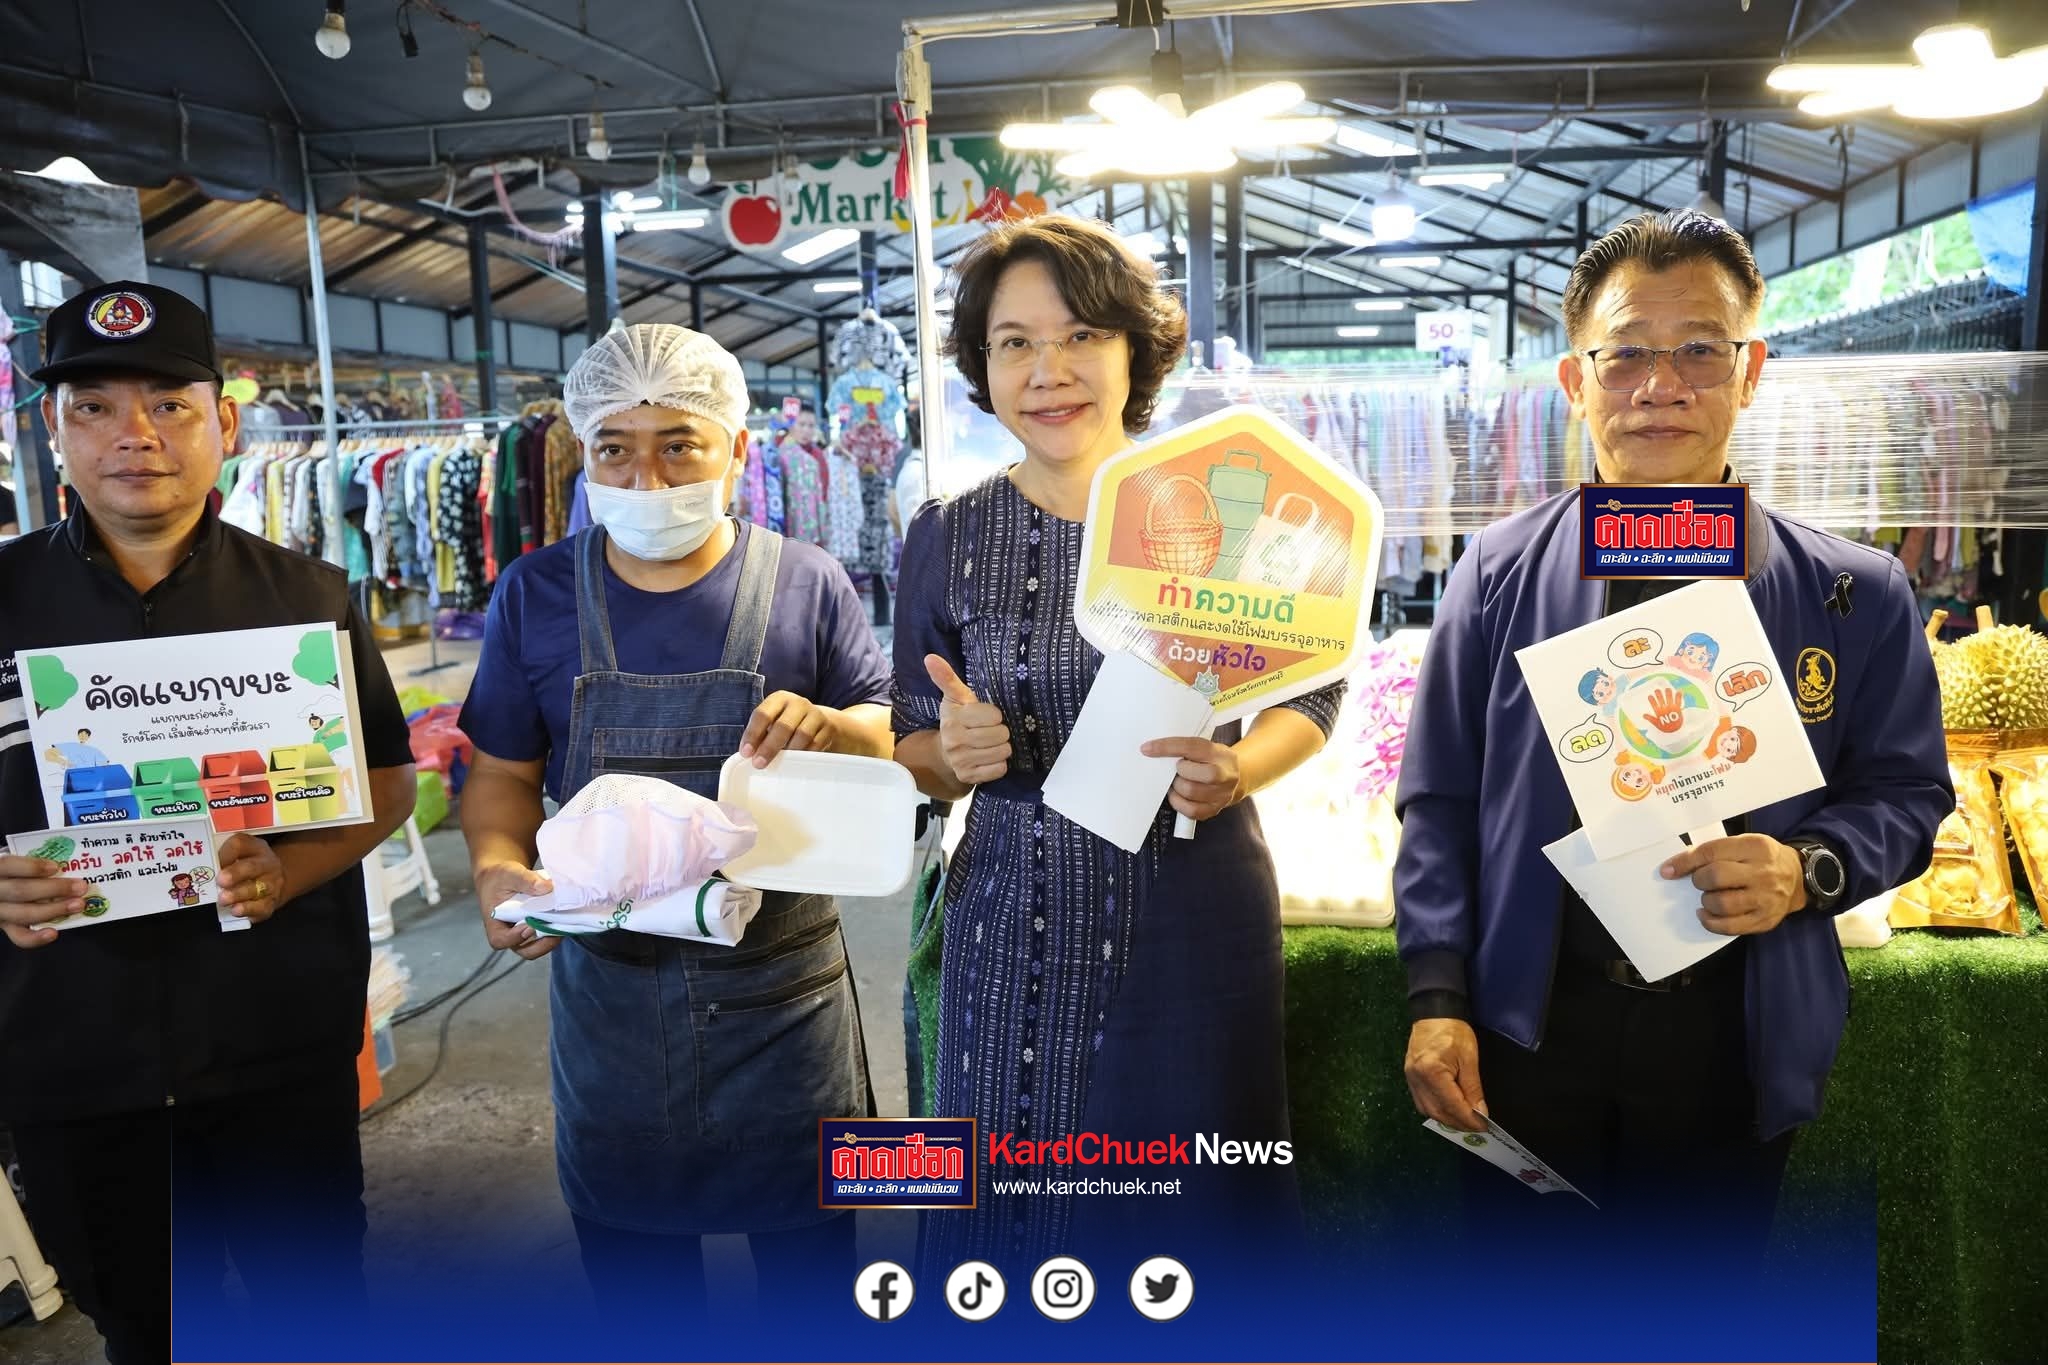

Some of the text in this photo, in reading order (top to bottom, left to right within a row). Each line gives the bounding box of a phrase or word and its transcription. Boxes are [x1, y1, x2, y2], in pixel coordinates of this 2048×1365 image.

[791, 179, 948, 225] Markt
[1157, 577, 1296, 623] ทำความดี
[1168, 639, 1266, 671] ด้วยหัวใจ
[1623, 637, 1651, 658] ละ
[85, 671, 292, 711] คัดแยกขยะ
[1722, 669, 1767, 697] เลิก
[151, 702, 233, 724] แยกขยะก่อนทิ้ง
[1659, 711, 1680, 726] NO
[1570, 730, 1606, 753] ลด
[1672, 779, 1724, 803] บรรจุอาหาร
[80, 808, 127, 823] ขยะทั่วไป
[154, 802, 198, 815] ขยะเปียก
[114, 845, 155, 864] ลดให้
[166, 841, 203, 858] ลดใช้
